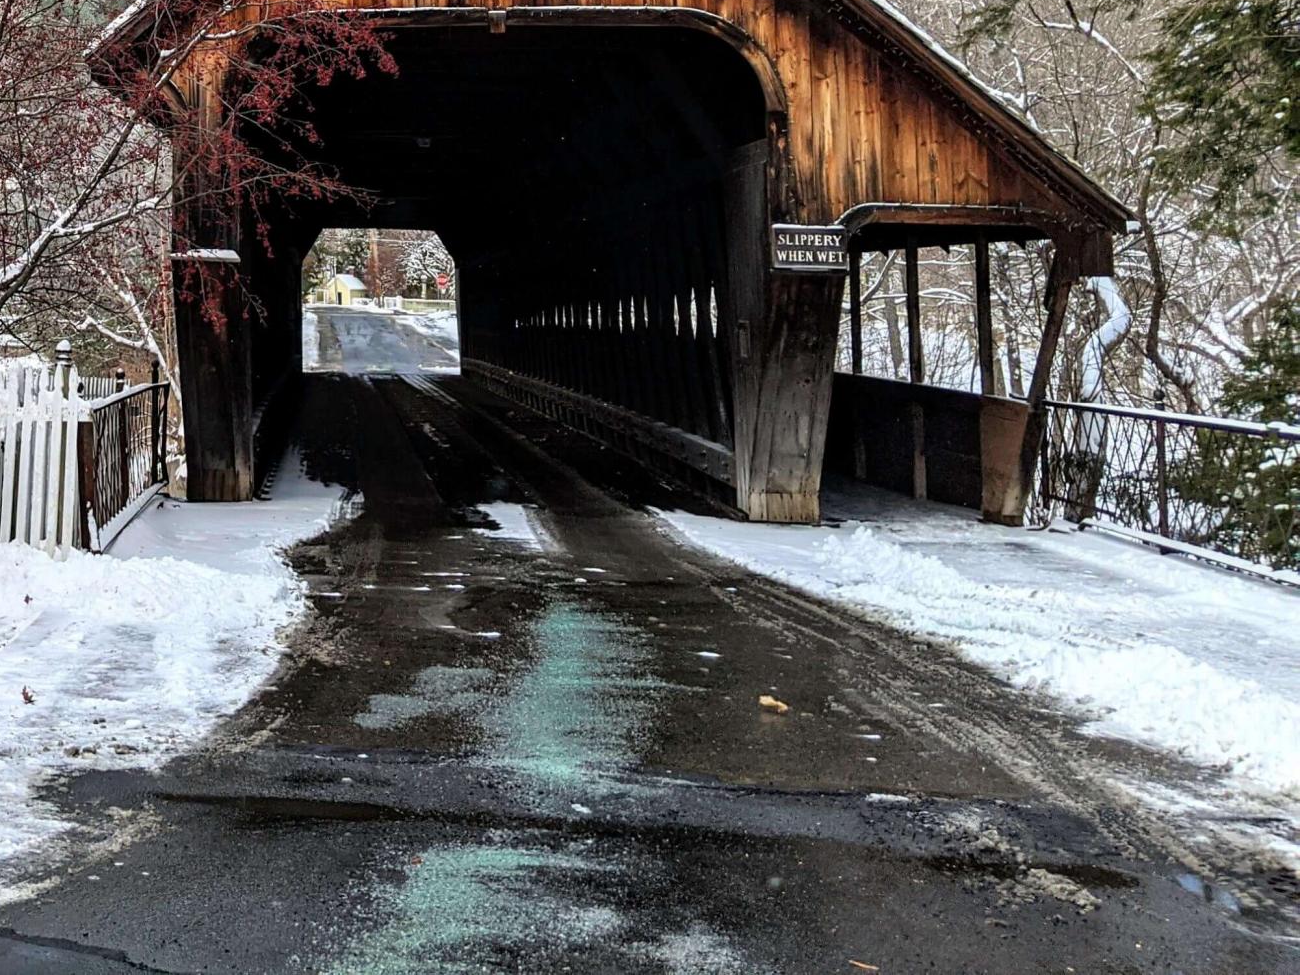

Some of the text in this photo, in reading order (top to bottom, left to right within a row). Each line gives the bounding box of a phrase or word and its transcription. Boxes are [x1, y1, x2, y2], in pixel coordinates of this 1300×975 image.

[777, 233, 842, 247] SLIPPERY
[776, 249, 844, 263] WHEN WET
